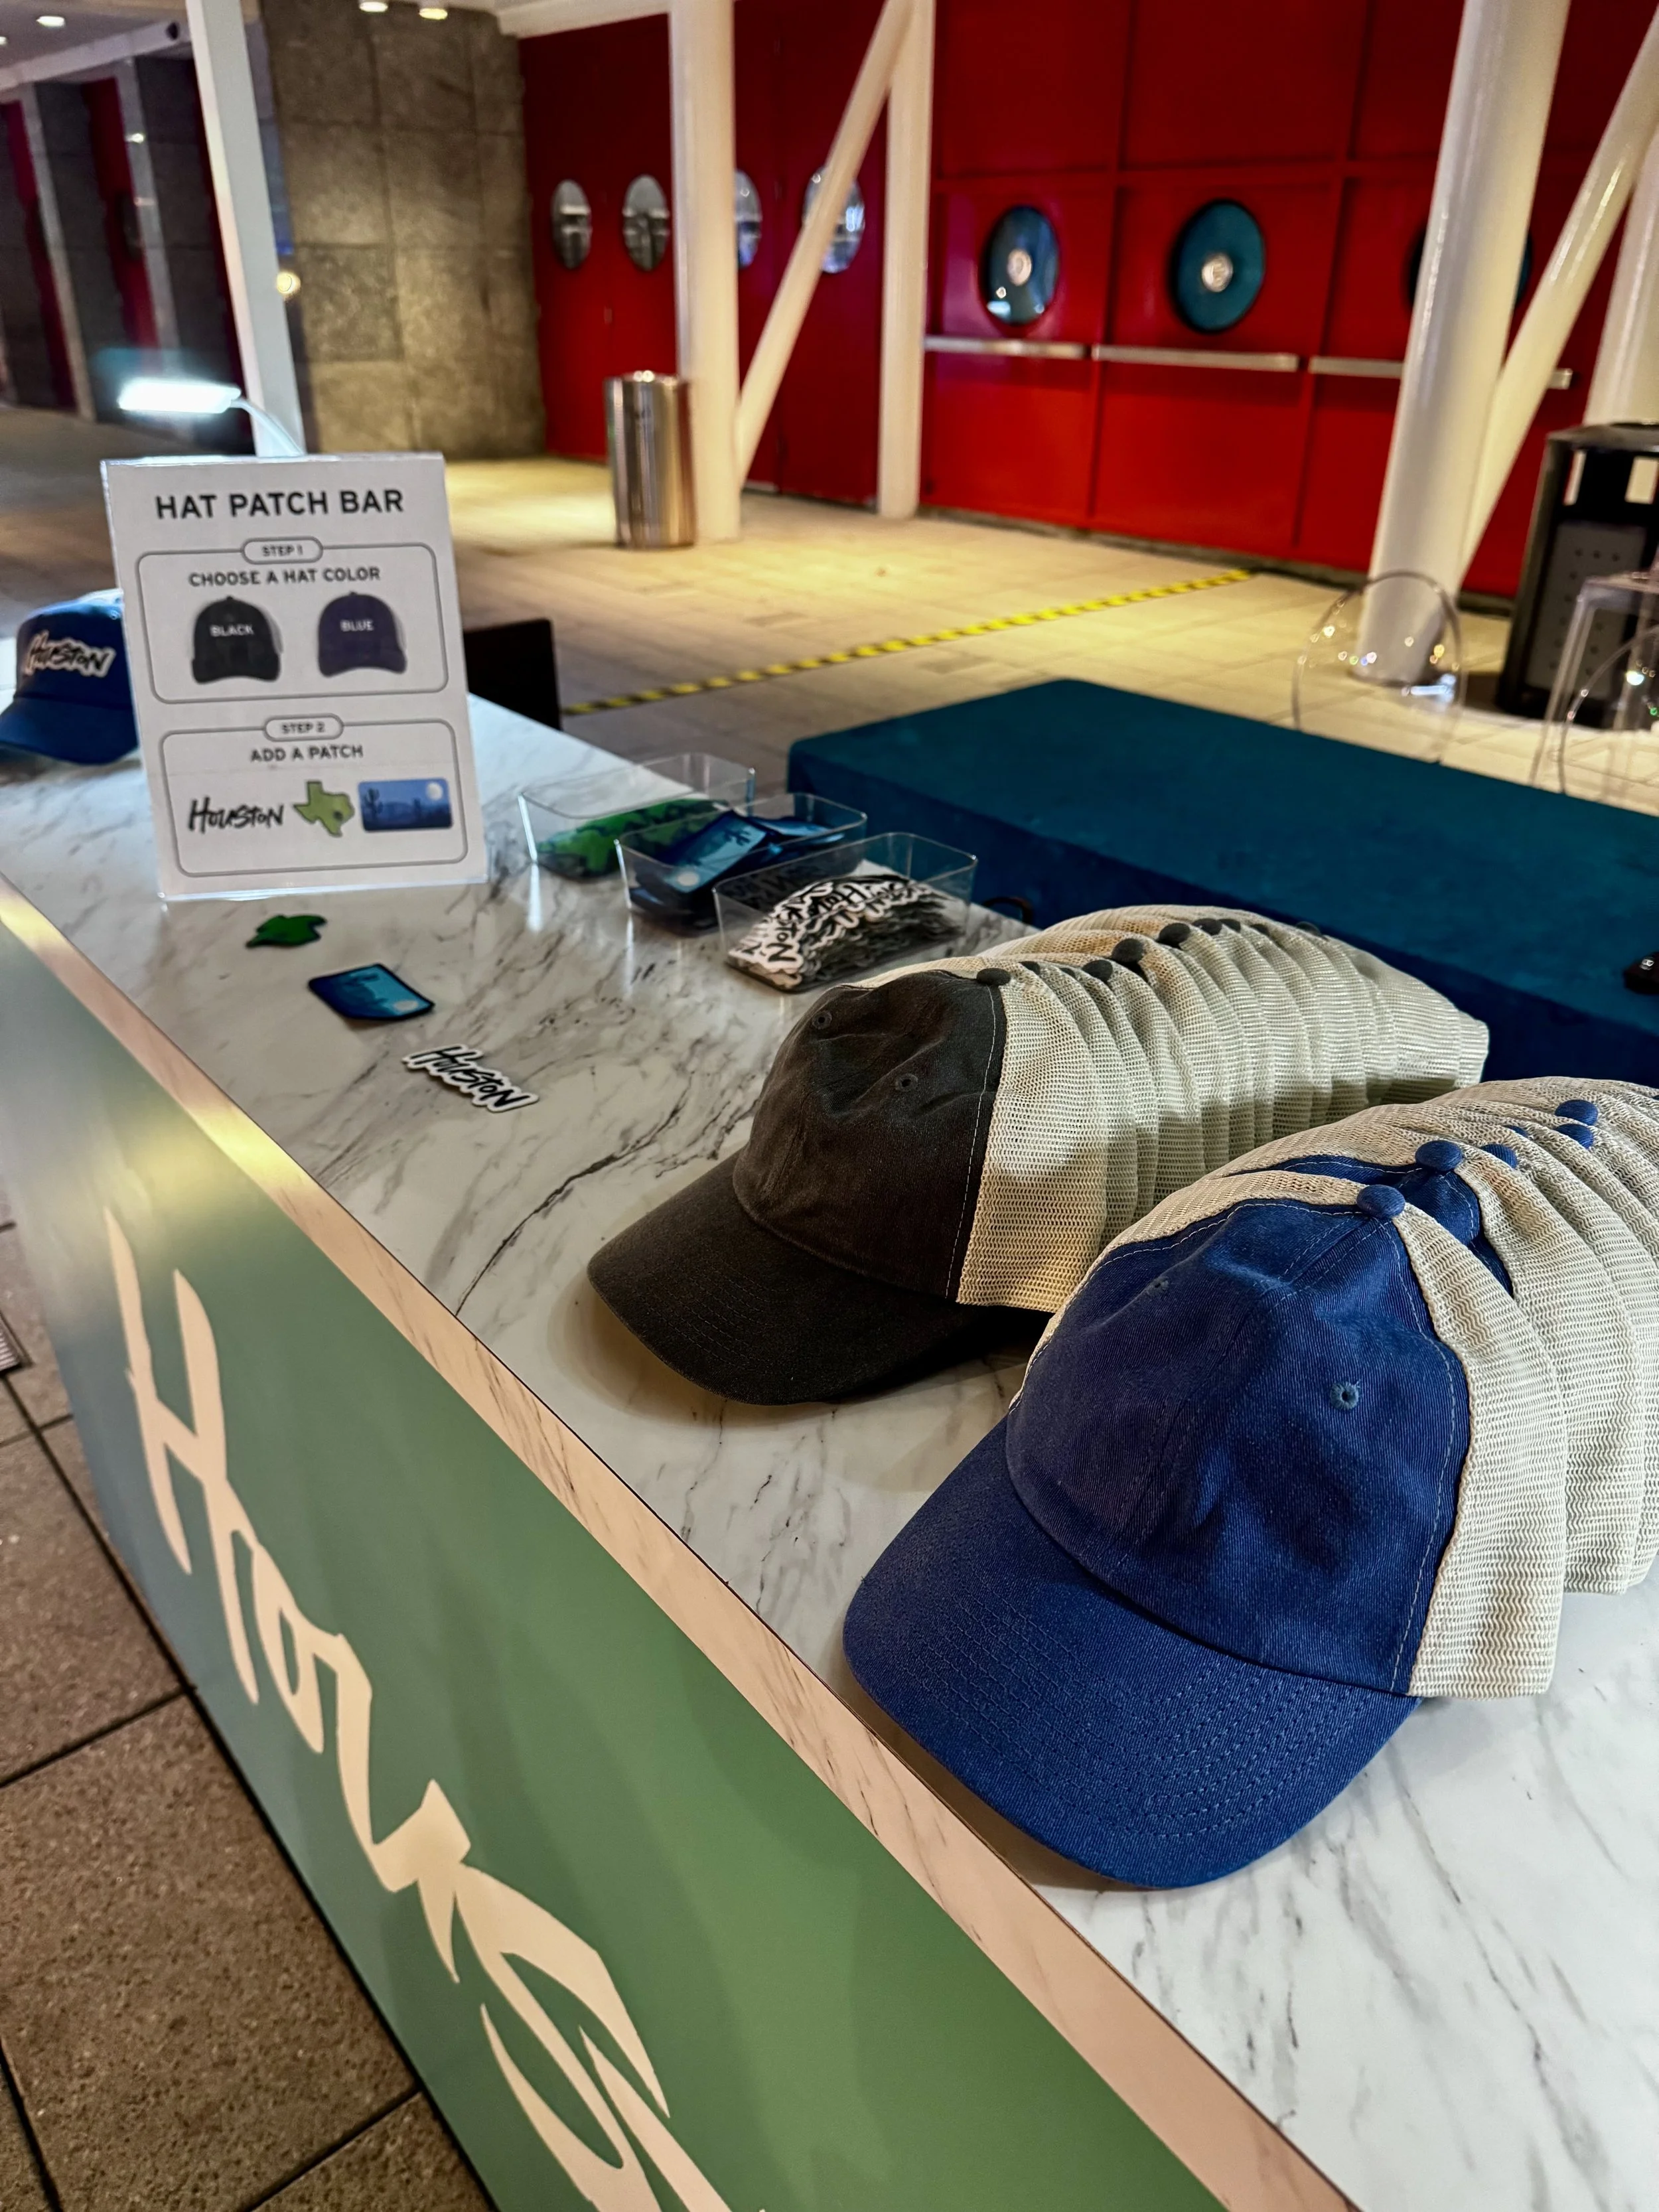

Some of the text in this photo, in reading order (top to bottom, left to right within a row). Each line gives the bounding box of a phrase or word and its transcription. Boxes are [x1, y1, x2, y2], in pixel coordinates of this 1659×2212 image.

[155, 489, 404, 520] HAT PATCH BAR
[261, 544, 303, 557] STEP 1
[188, 567, 381, 587] CHOOSE A HAT COLOR
[210, 625, 255, 637] BLACK
[340, 619, 374, 632] BLUE
[281, 721, 326, 735] STEP 2
[251, 744, 364, 763] ADD A PATCH
